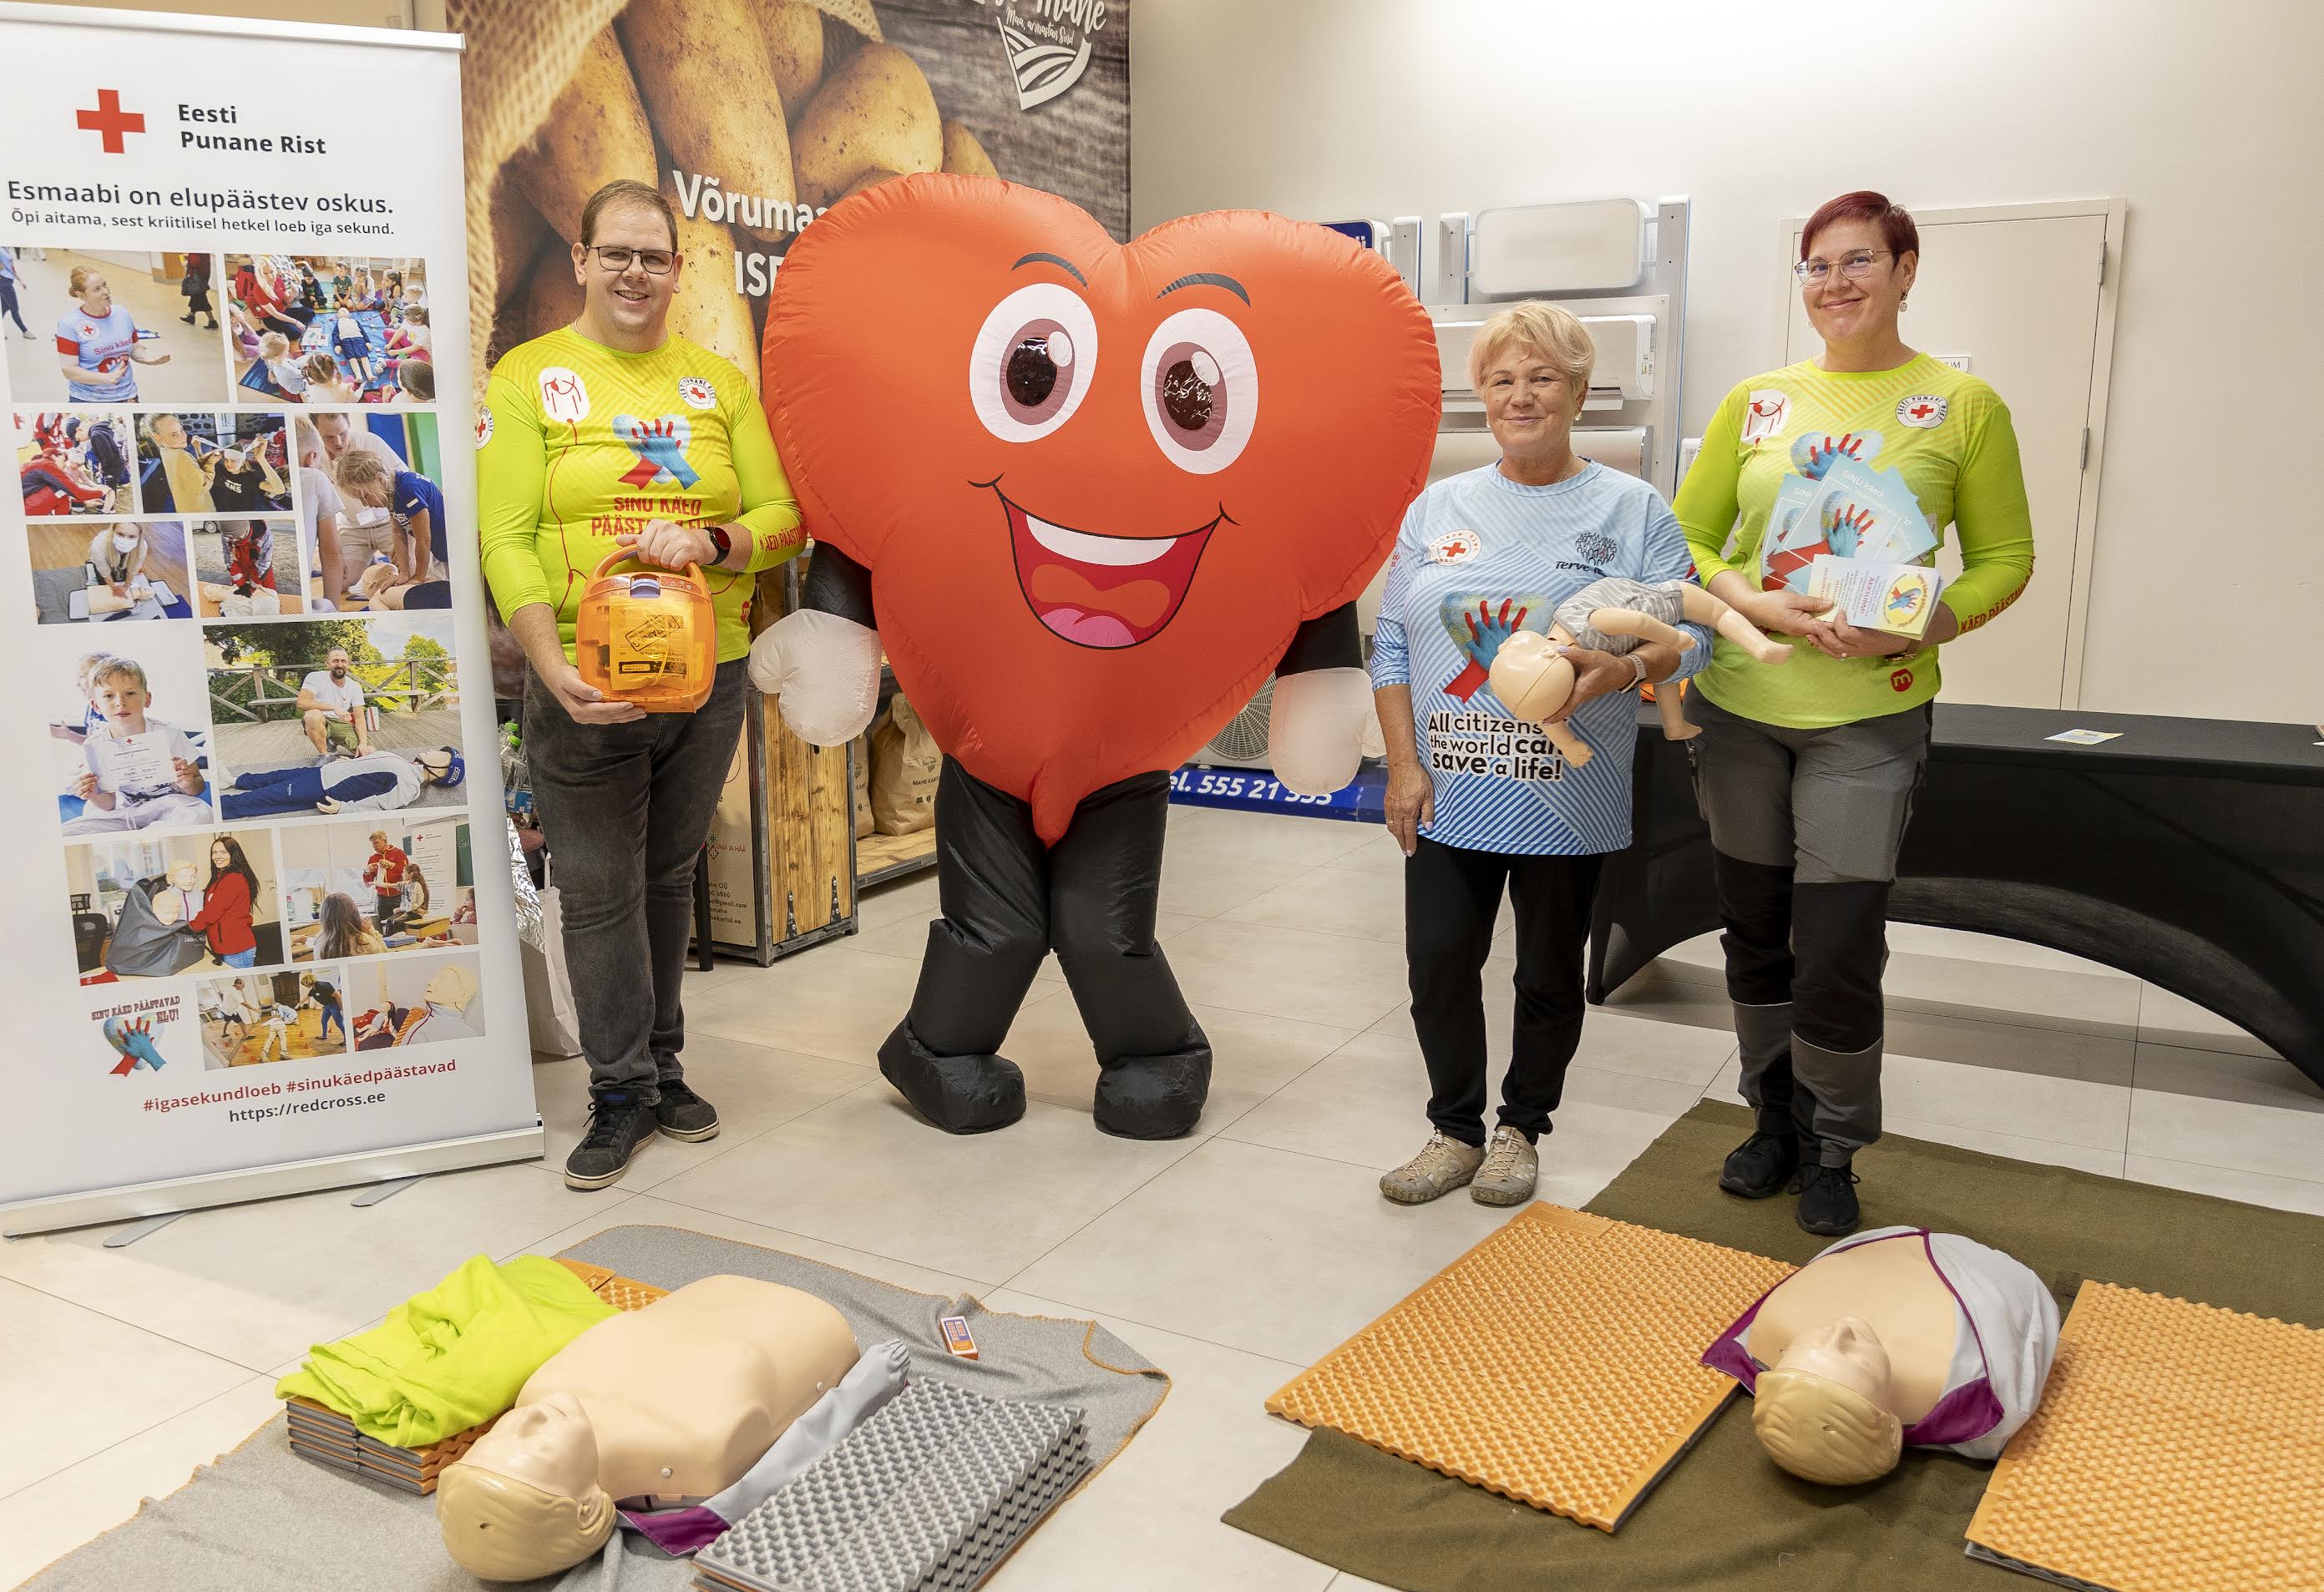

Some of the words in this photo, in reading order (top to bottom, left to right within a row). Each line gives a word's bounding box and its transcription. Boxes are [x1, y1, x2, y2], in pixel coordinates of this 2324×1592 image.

[178, 104, 237, 124] Eesti
[180, 131, 273, 152] Punane
[281, 134, 327, 154] Rist
[8, 180, 120, 204] Esmaabi
[129, 190, 161, 206] on
[170, 188, 308, 214] elupäästev
[316, 193, 393, 214] oskus.
[672, 169, 828, 234] Võruma
[12, 208, 39, 225] Õpi
[45, 211, 107, 227] aitama,
[112, 215, 144, 227] sest
[149, 215, 217, 230] kriitilisel
[222, 218, 270, 231] hetkel
[275, 220, 306, 232] loeb
[311, 221, 332, 236] iga
[337, 222, 395, 235] sekund.
[1938, 405, 1947, 421] RIST
[613, 497, 654, 513] SINU
[660, 496, 702, 516] KÄED
[1427, 712, 1451, 733] All
[1454, 712, 1543, 735] citizens
[1430, 734, 1448, 750] the
[1449, 735, 1511, 756] world
[1432, 752, 1488, 775] save
[1495, 763, 1508, 776] a
[1514, 756, 1562, 781] life!
[1170, 771, 1191, 792] el.
[1197, 775, 1246, 796] 555
[1248, 779, 1281, 801] 21
[91, 1008, 110, 1021] SINU
[111, 1004, 133, 1017] KÄED
[134, 995, 180, 1013] PÄÄSTAVAD
[156, 1008, 180, 1023] ELU!
[143, 1082, 281, 1113] #igasekundloeb
[286, 1059, 457, 1093] #sinukäedpäästavad
[229, 1093, 386, 1123] https://redcross.ee
